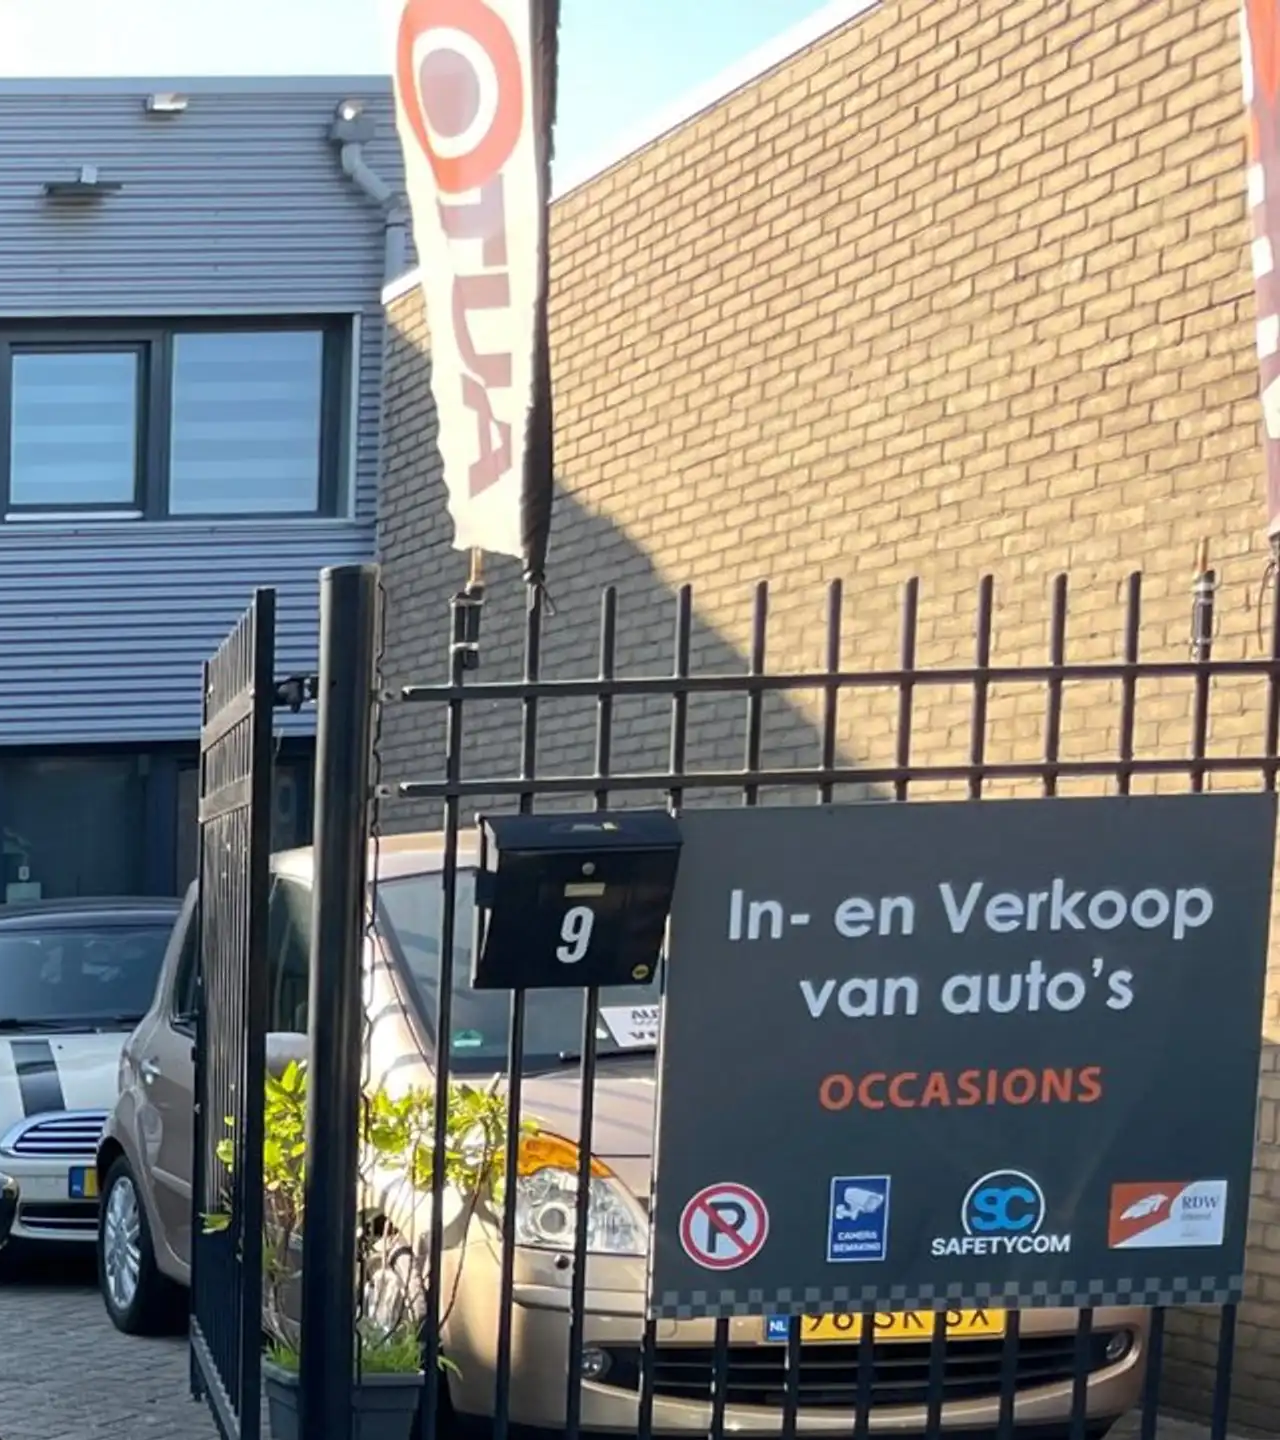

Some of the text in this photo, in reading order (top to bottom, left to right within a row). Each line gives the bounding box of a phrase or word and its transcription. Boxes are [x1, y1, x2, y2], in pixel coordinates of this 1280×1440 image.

[729, 878, 1214, 940] In- en Verkoop
[556, 906, 595, 963] 9
[800, 957, 1135, 1018] van auto's
[818, 1066, 1102, 1110] OCCASIONS
[970, 1186, 1036, 1231] SC
[1182, 1195, 1219, 1210] RDW
[931, 1233, 1072, 1256] SAFETYCOM
[769, 1320, 787, 1332] NL
